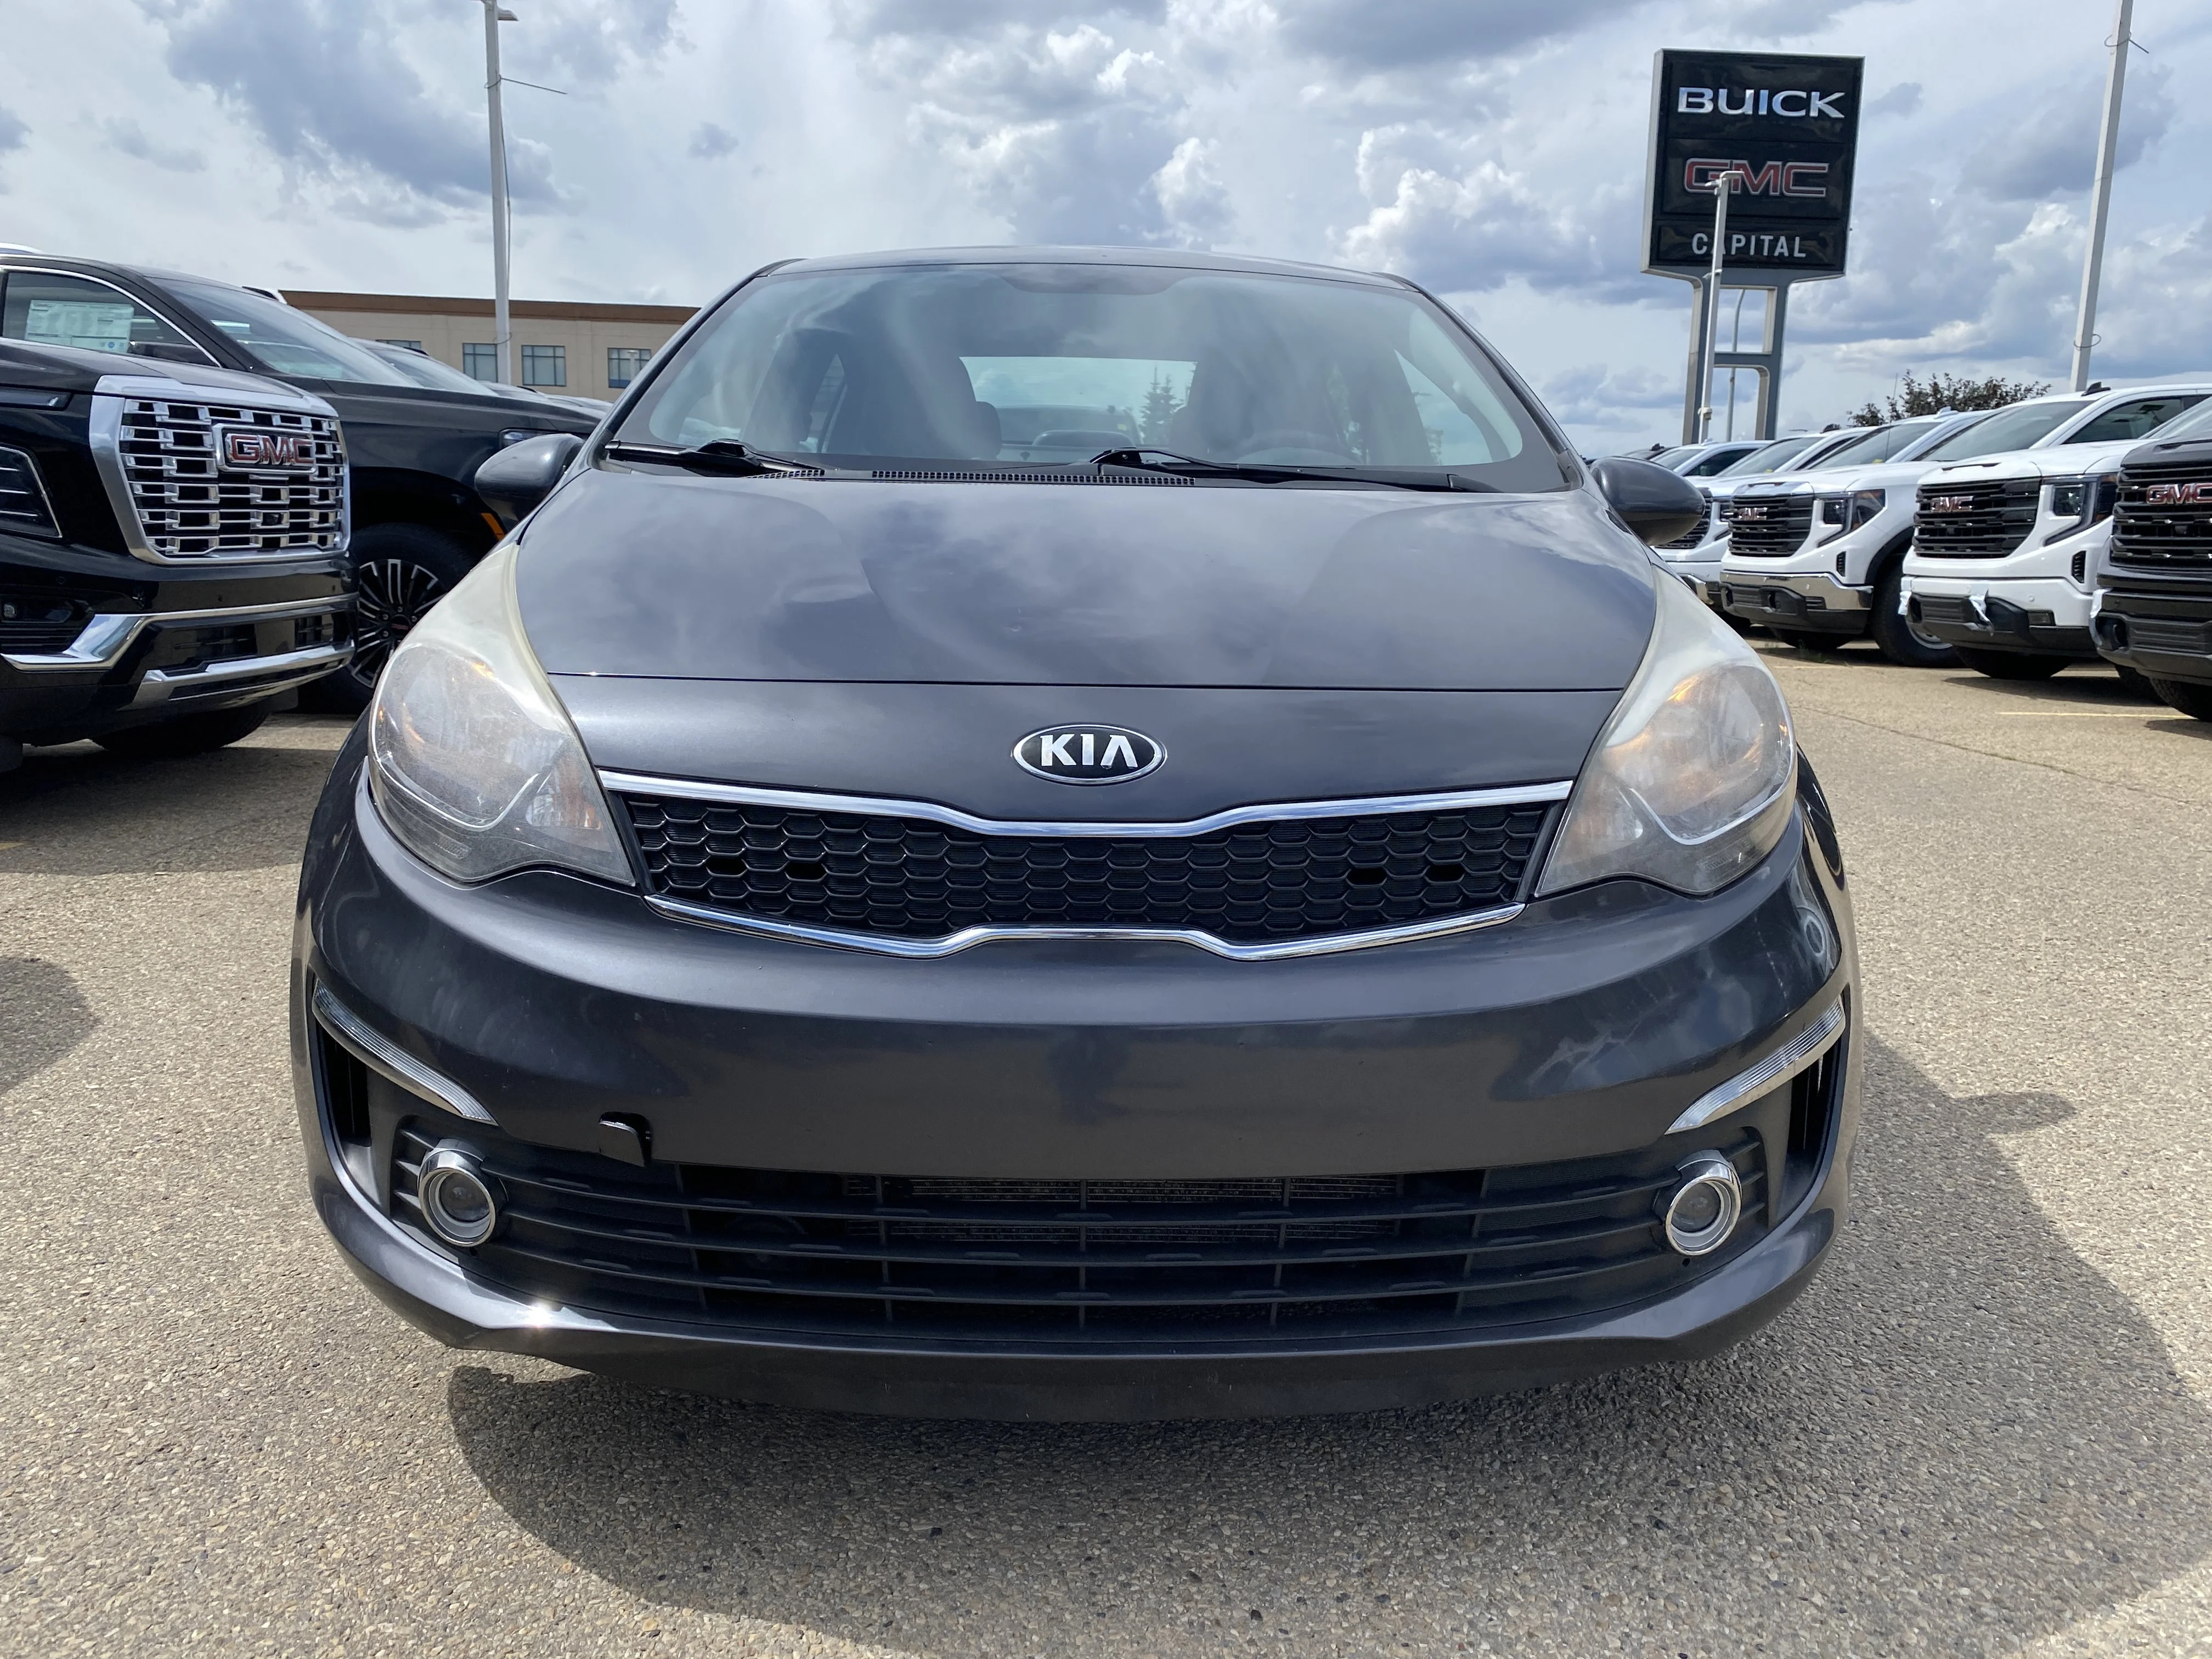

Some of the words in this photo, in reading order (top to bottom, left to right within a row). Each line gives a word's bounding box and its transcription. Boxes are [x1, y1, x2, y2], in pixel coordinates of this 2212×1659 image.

[1678, 87, 1846, 118] BUICK
[1684, 157, 1829, 198] GMC
[1692, 233, 1807, 258] CPITAL
[225, 433, 315, 466] GMC
[1931, 495, 1974, 512] GMC
[2146, 483, 2212, 505] GMC
[1040, 733, 1138, 769] KIA
